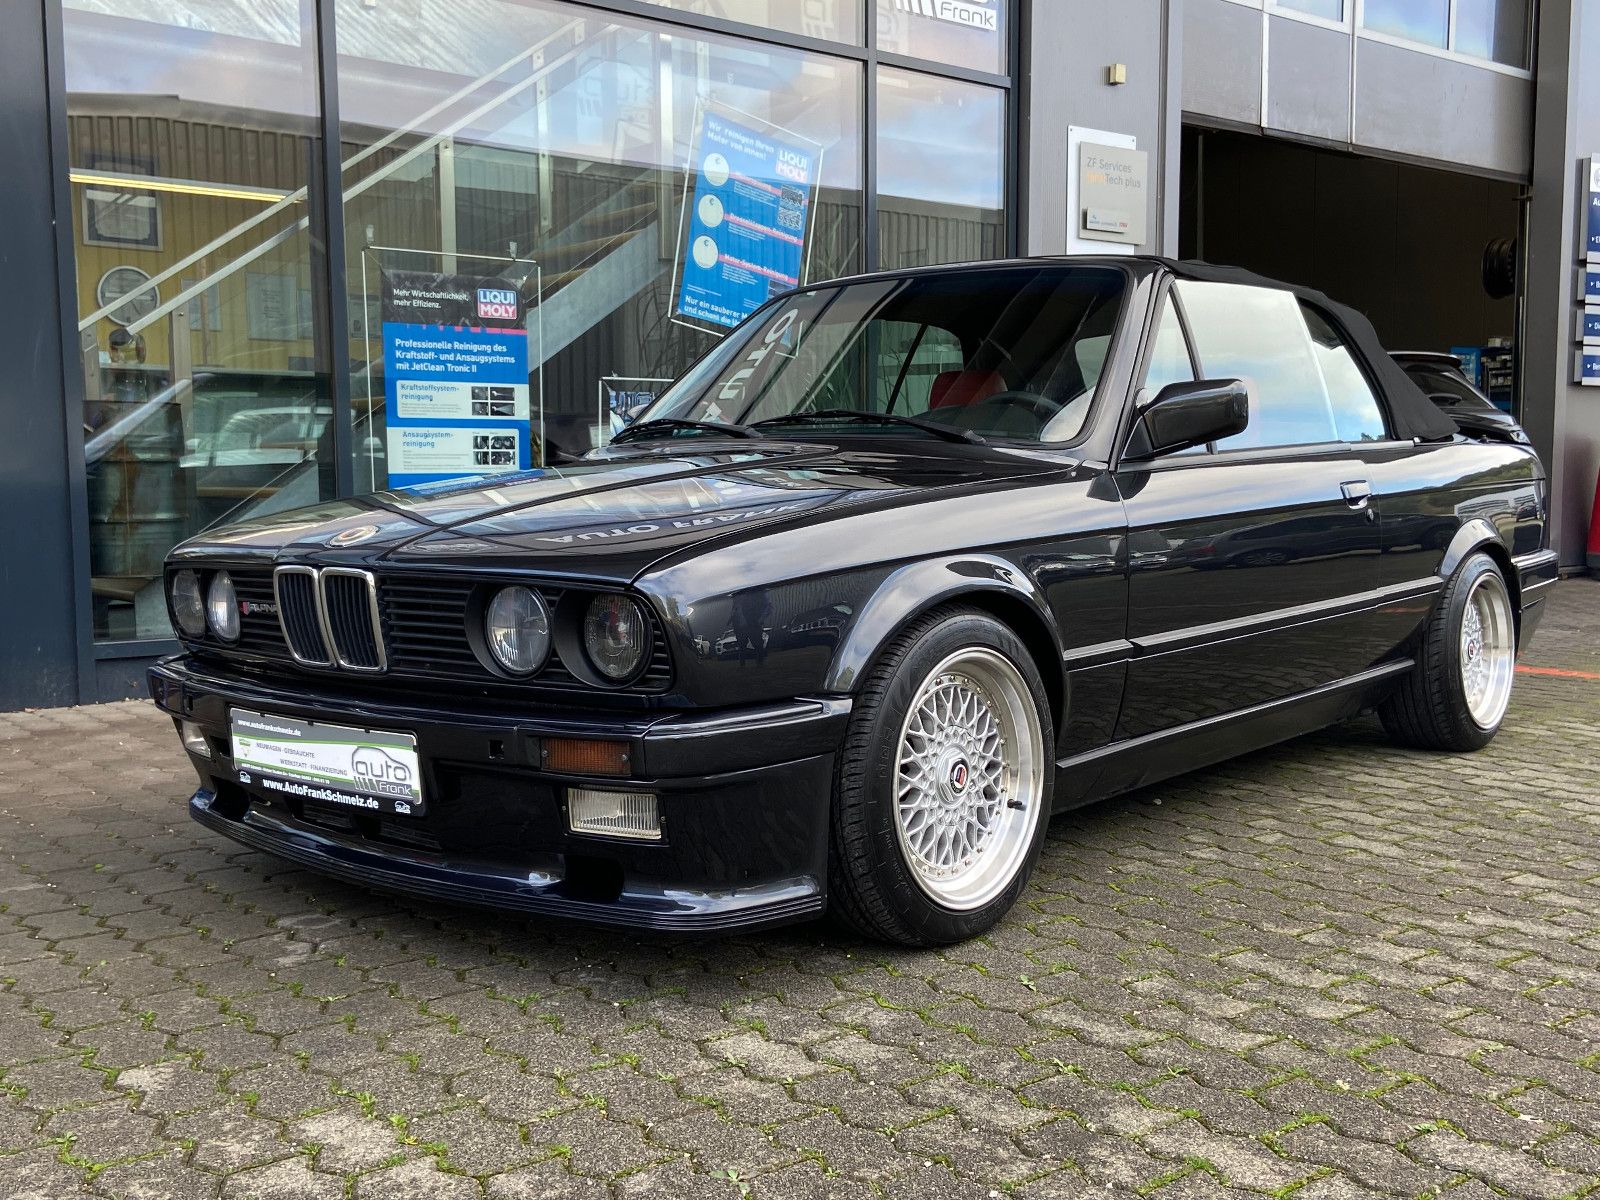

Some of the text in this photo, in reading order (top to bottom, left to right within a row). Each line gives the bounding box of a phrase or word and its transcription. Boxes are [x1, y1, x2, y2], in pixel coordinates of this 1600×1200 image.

[940, 1, 993, 27] Frank
[708, 120, 722, 131] Wir
[730, 141, 743, 152] von
[779, 150, 808, 169] LIQUI
[1087, 156, 1132, 174] ZF Services
[777, 162, 808, 182] MOLY
[1125, 176, 1141, 188] plus
[393, 289, 469, 302] Mehr Wirtschaftlichkeit,
[479, 290, 515, 304] LIQUI
[393, 299, 441, 309] mehr Effizienz.
[480, 304, 516, 318] MOLY
[685, 294, 699, 306] Nur
[699, 300, 710, 309] ein
[710, 304, 740, 319] sauberer
[684, 305, 698, 314] und
[720, 316, 731, 324] die
[395, 338, 507, 353] Professionelle Reinigung des
[395, 350, 516, 365] Kraftstoff- und Ansaugsystems
[396, 362, 411, 371] mit
[411, 363, 446, 372] JetClean
[447, 364, 470, 373] Tronic
[400, 383, 460, 393] Kraftstoffsystem-
[401, 393, 434, 402] reinigung
[402, 431, 454, 440] Ansaugsystem-
[402, 440, 435, 449] reinigung
[256, 742, 282, 752] NEUWAGEN
[280, 759, 308, 769] WERKSTATT
[355, 760, 407, 781] auto
[263, 778, 379, 809] www.AutoFrankSchmelz.de
[379, 782, 412, 796] Frank
